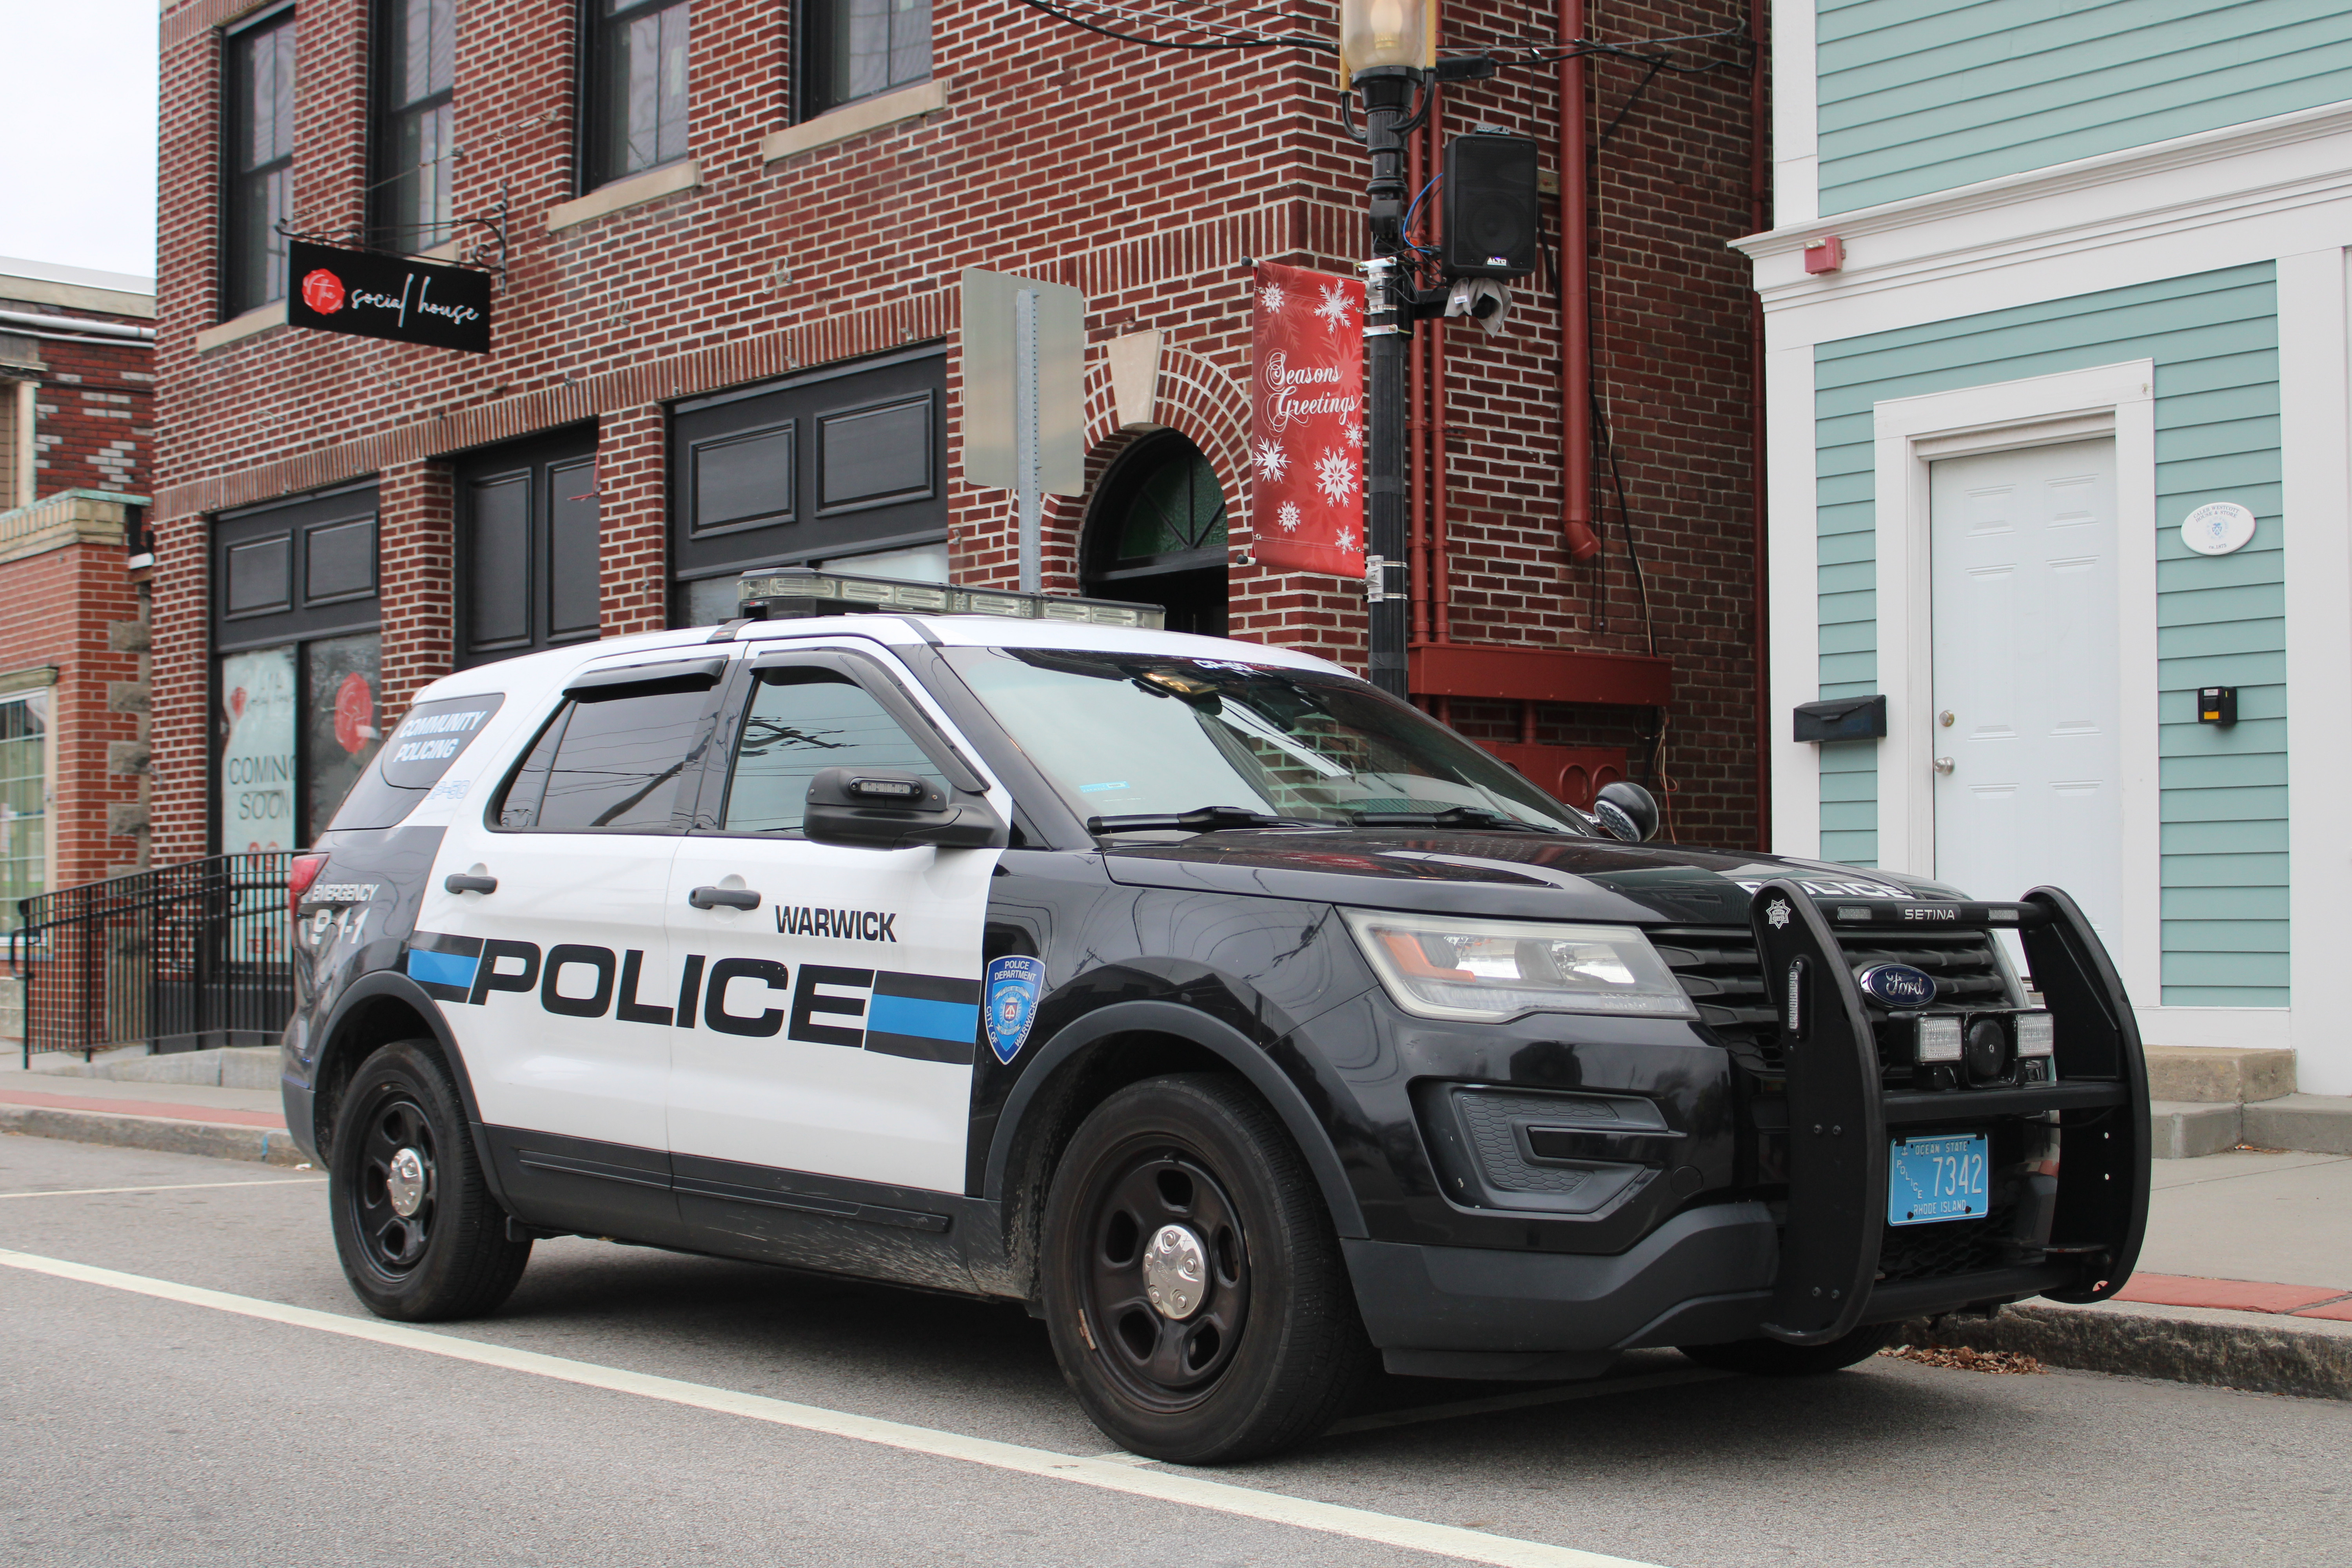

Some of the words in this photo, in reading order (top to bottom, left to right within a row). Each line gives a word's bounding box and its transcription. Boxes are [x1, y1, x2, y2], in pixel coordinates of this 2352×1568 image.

[351, 273, 414, 327] social
[418, 276, 479, 325] house
[1266, 352, 1343, 392] Seasons
[1267, 386, 1363, 432] Greetings
[2193, 508, 2210, 518] CALEB
[2195, 512, 2212, 522] HOUSE
[1192, 659, 1254, 671] CP-50
[399, 710, 488, 739] COMMUNITY
[392, 738, 460, 762] POLICING
[239, 791, 291, 820] SOON
[311, 884, 380, 901] EMERGENCY
[1735, 881, 1915, 900] PLICE
[775, 905, 897, 942] WARWICK
[1905, 909, 1955, 920] SETINA
[995, 970, 1036, 982] DEPARTMENT
[1005, 961, 1030, 970] POLICE
[470, 938, 875, 1049] POLICE
[1886, 971, 1924, 995] Ford
[991, 1031, 998, 1044] OF
[1014, 1001, 1036, 1047] WARWICK
[1915, 1143, 1940, 1155] OCEAN
[1945, 1140, 1968, 1153] STATE
[1896, 1160, 1922, 1199] POLICE
[1933, 1154, 1982, 1197] 7342
[1913, 1202, 1937, 1216] RHODE
[1941, 1199, 1966, 1213] ISLAND
